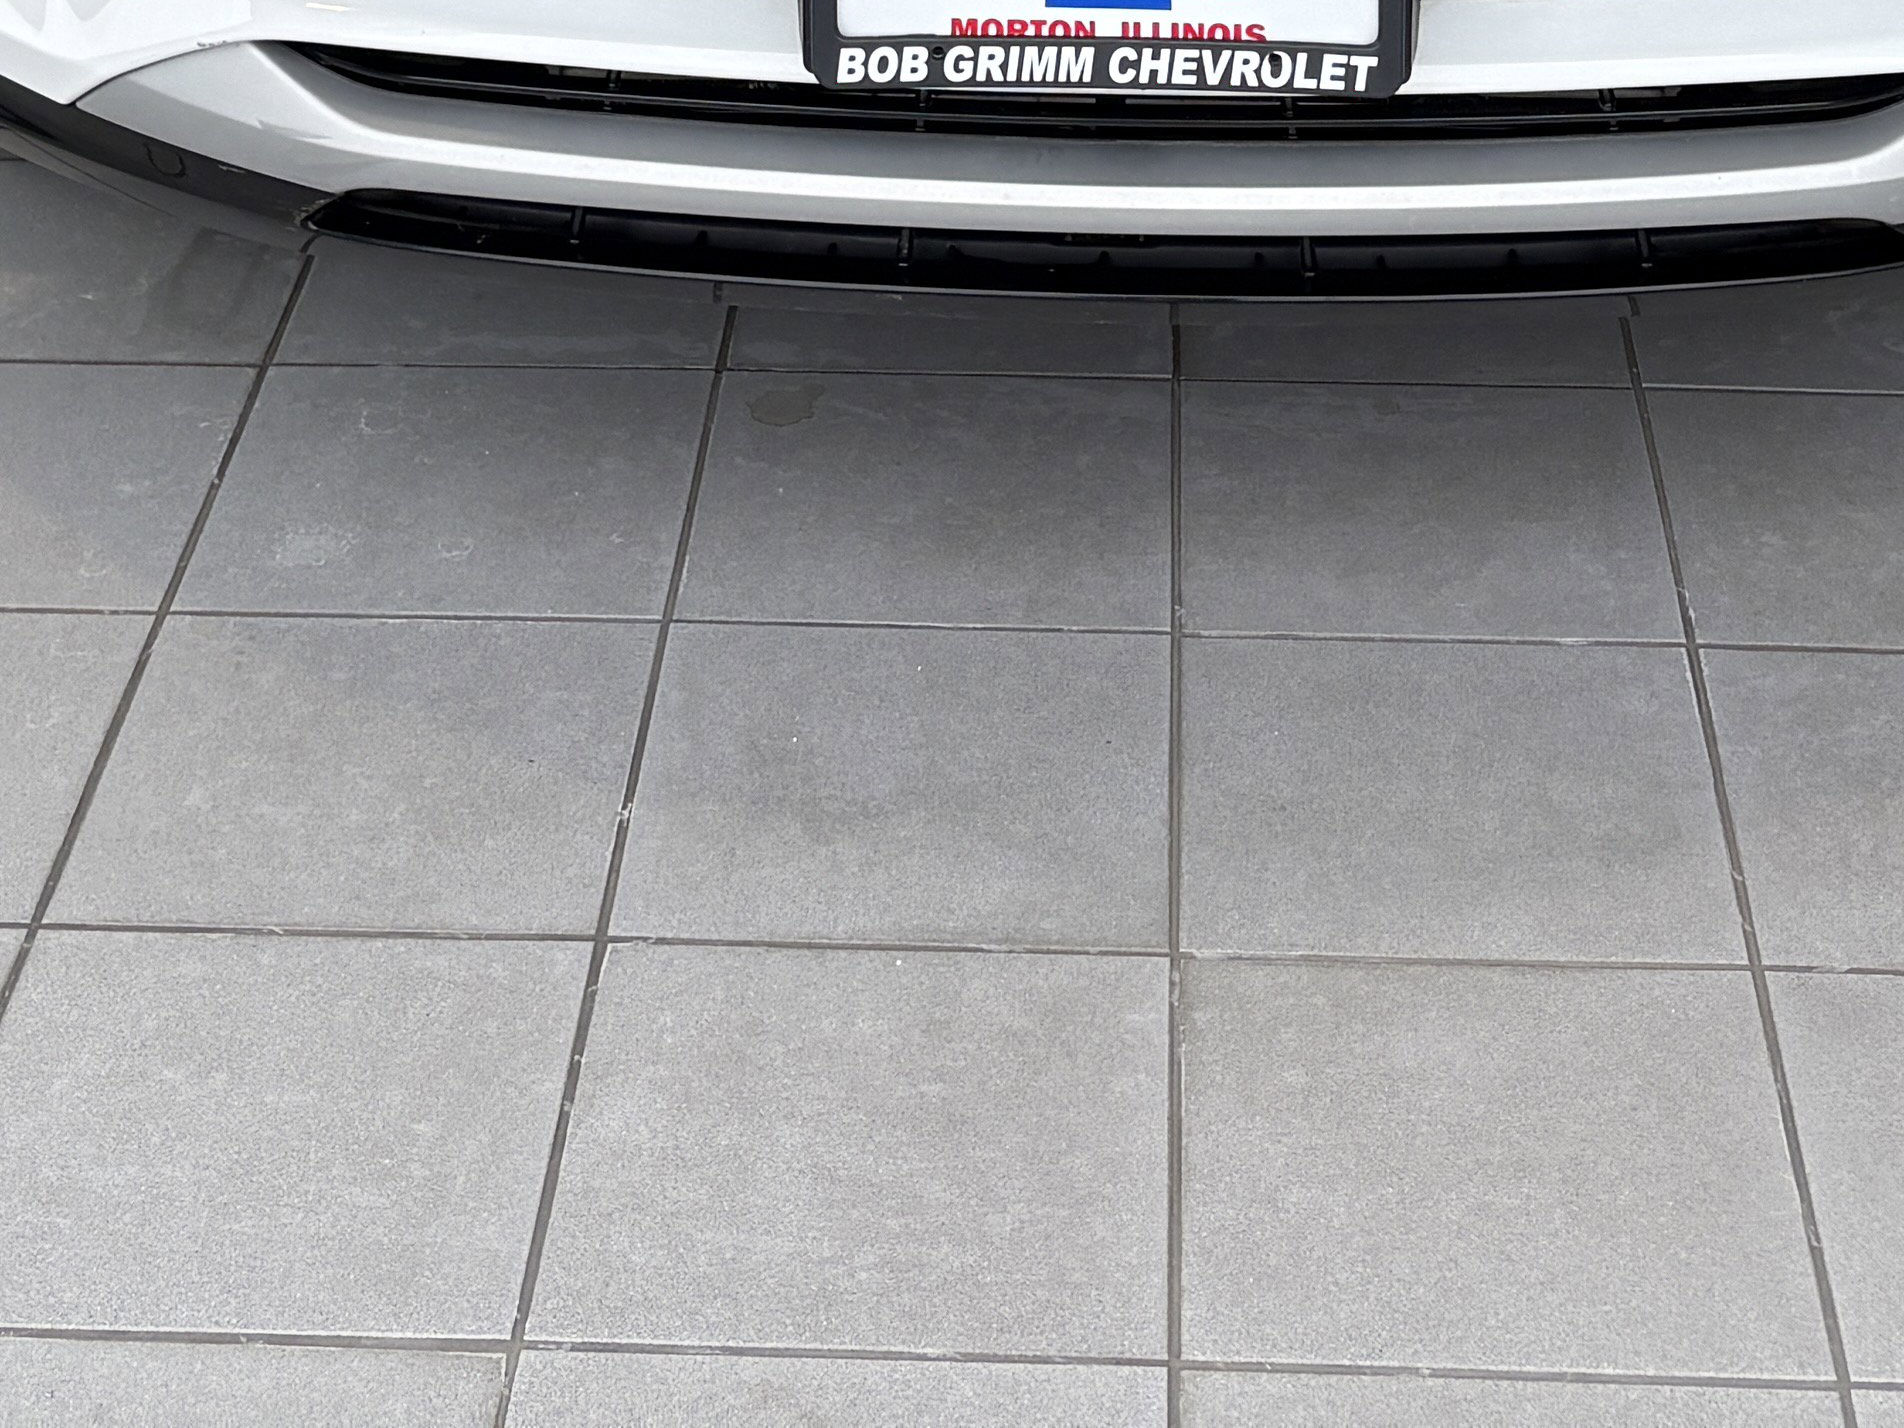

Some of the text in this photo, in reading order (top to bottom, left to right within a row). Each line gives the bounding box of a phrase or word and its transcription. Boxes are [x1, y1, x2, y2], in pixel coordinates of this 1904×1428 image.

[836, 46, 1379, 93] BOB GRIMM CHEVROLET
